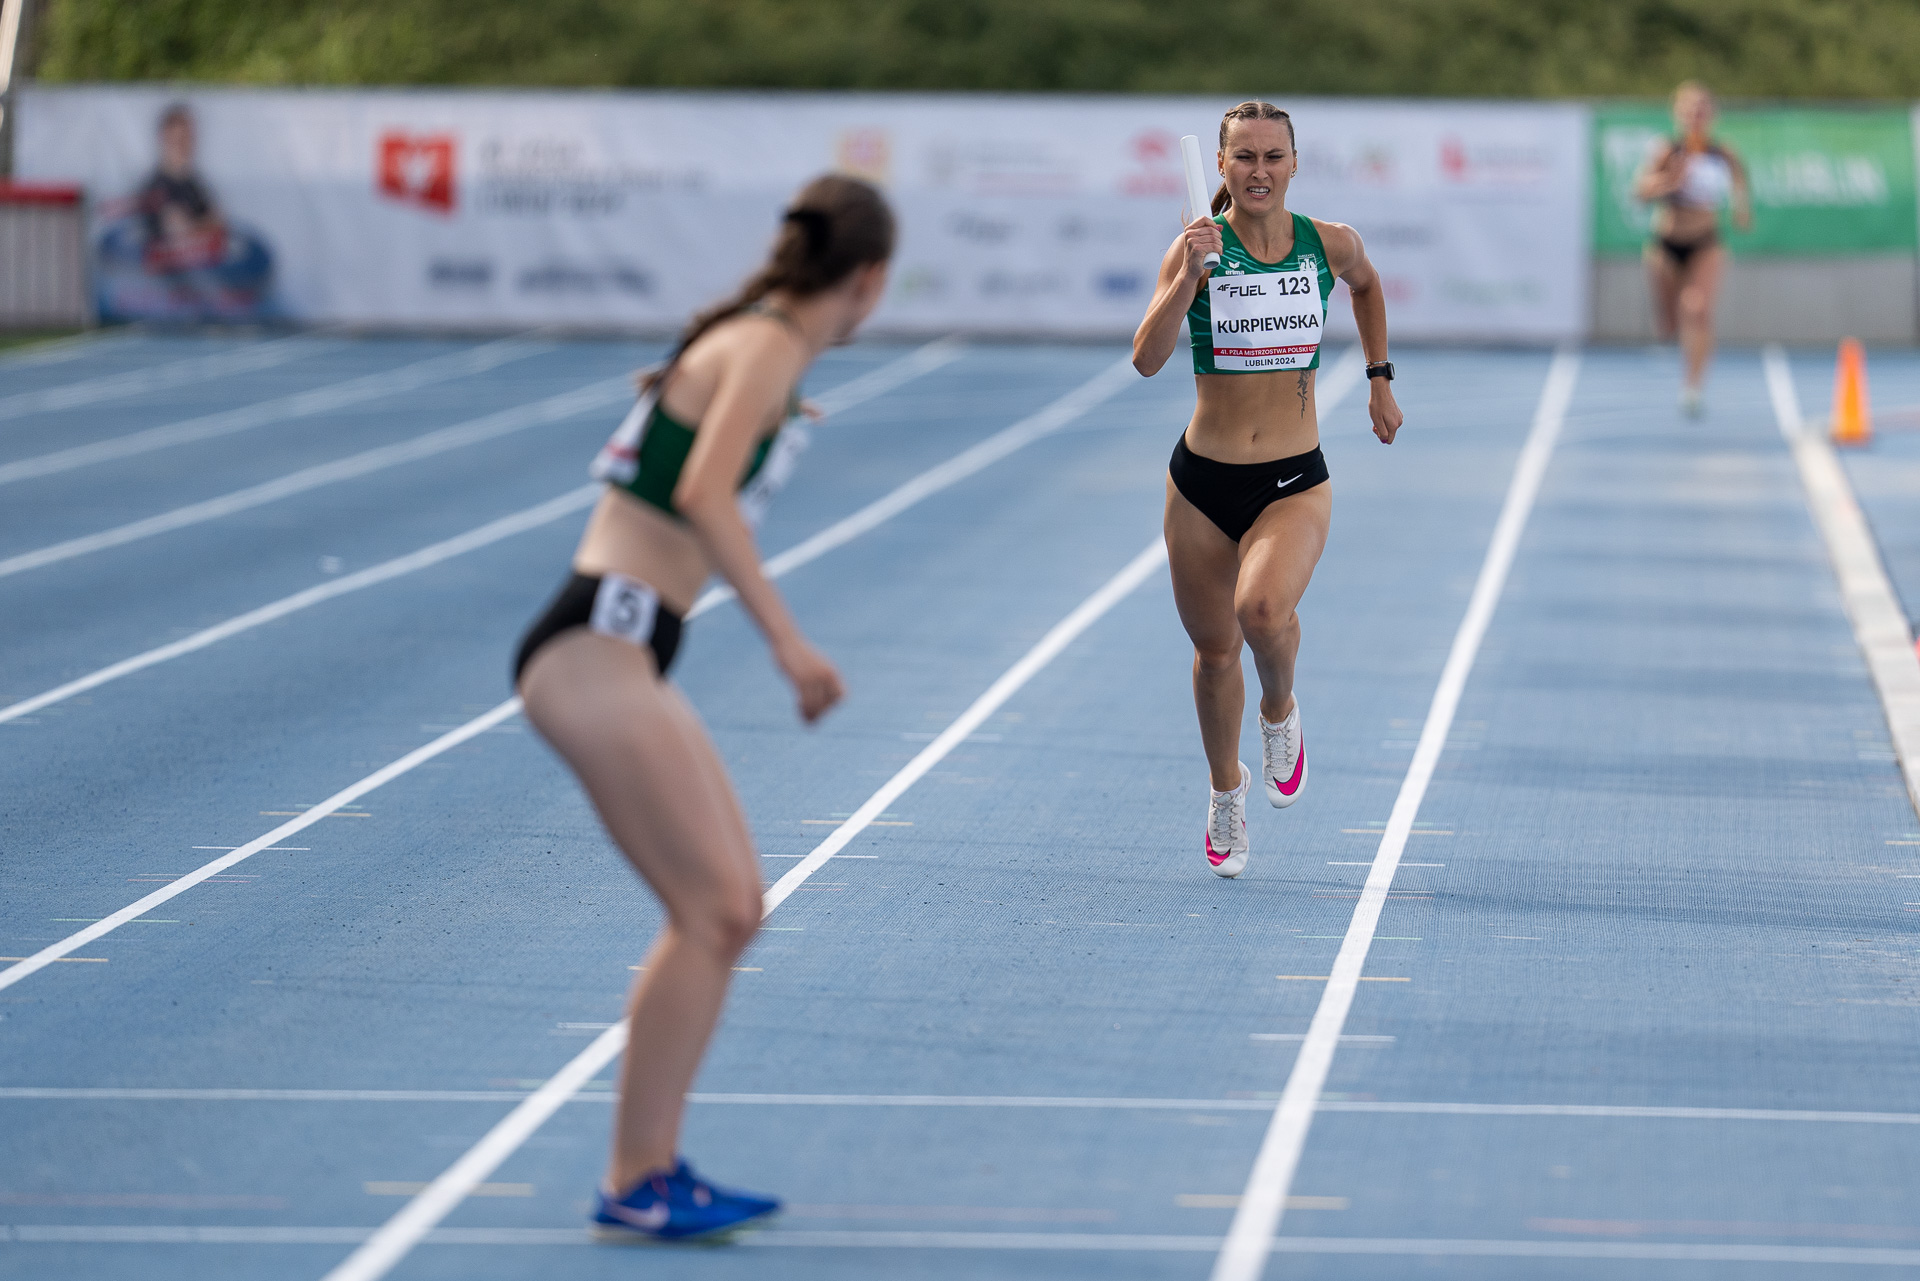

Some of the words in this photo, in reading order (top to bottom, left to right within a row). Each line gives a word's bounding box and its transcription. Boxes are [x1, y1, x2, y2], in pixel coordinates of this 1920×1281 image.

[1230, 285, 1267, 297] FUEL
[1278, 277, 1310, 296] 123
[1217, 314, 1319, 334] KURPIEWSKA
[1244, 348, 1286, 356] MISTRZOSTWA
[1288, 346, 1308, 354] POLSKI
[1245, 358, 1273, 367] LUBLIN
[1275, 356, 1296, 365] 2024
[606, 589, 642, 635] 5
